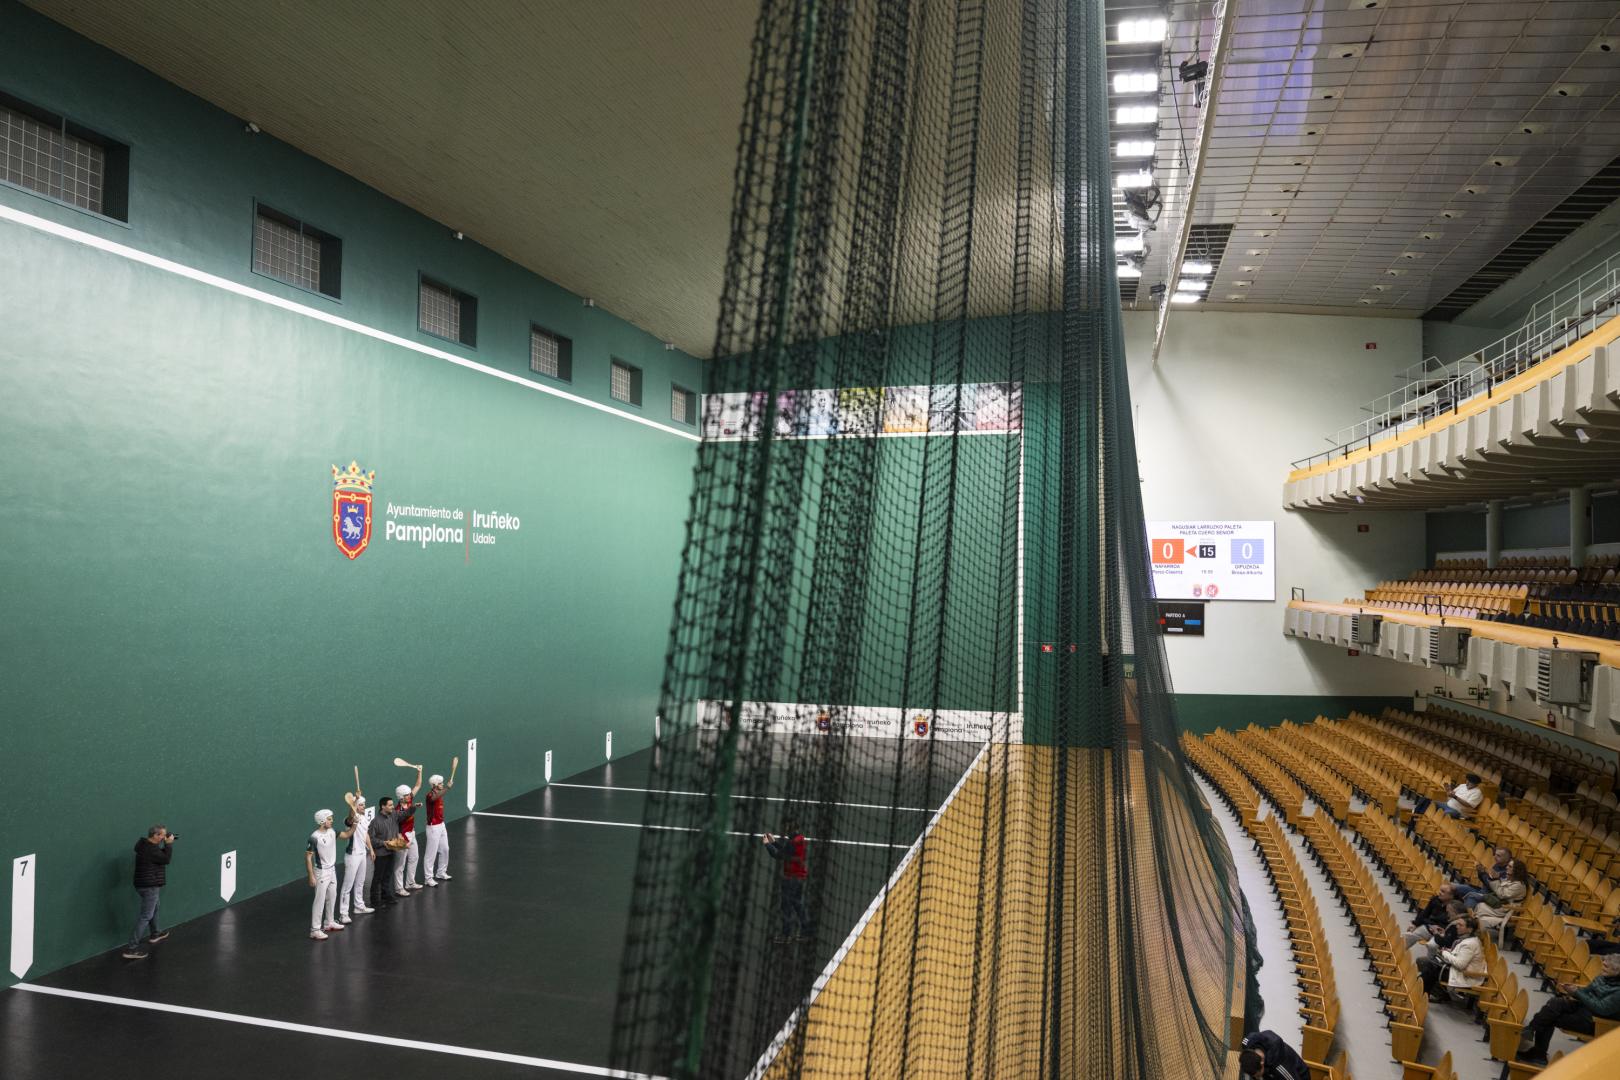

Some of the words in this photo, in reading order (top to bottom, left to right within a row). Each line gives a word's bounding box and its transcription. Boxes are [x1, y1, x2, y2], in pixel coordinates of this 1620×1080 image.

[386, 502, 452, 521] Ayuntamiento
[453, 508, 464, 520] de
[472, 510, 520, 531] Iruñeko
[386, 520, 464, 549] Pamplona
[472, 533, 496, 545] Udala
[1162, 542, 1174, 559] 0
[1201, 546, 1214, 557] 15
[1241, 542, 1253, 559] 0
[367, 810, 372, 822] 5
[20, 859, 29, 877] 7
[225, 855, 232, 869] 6
